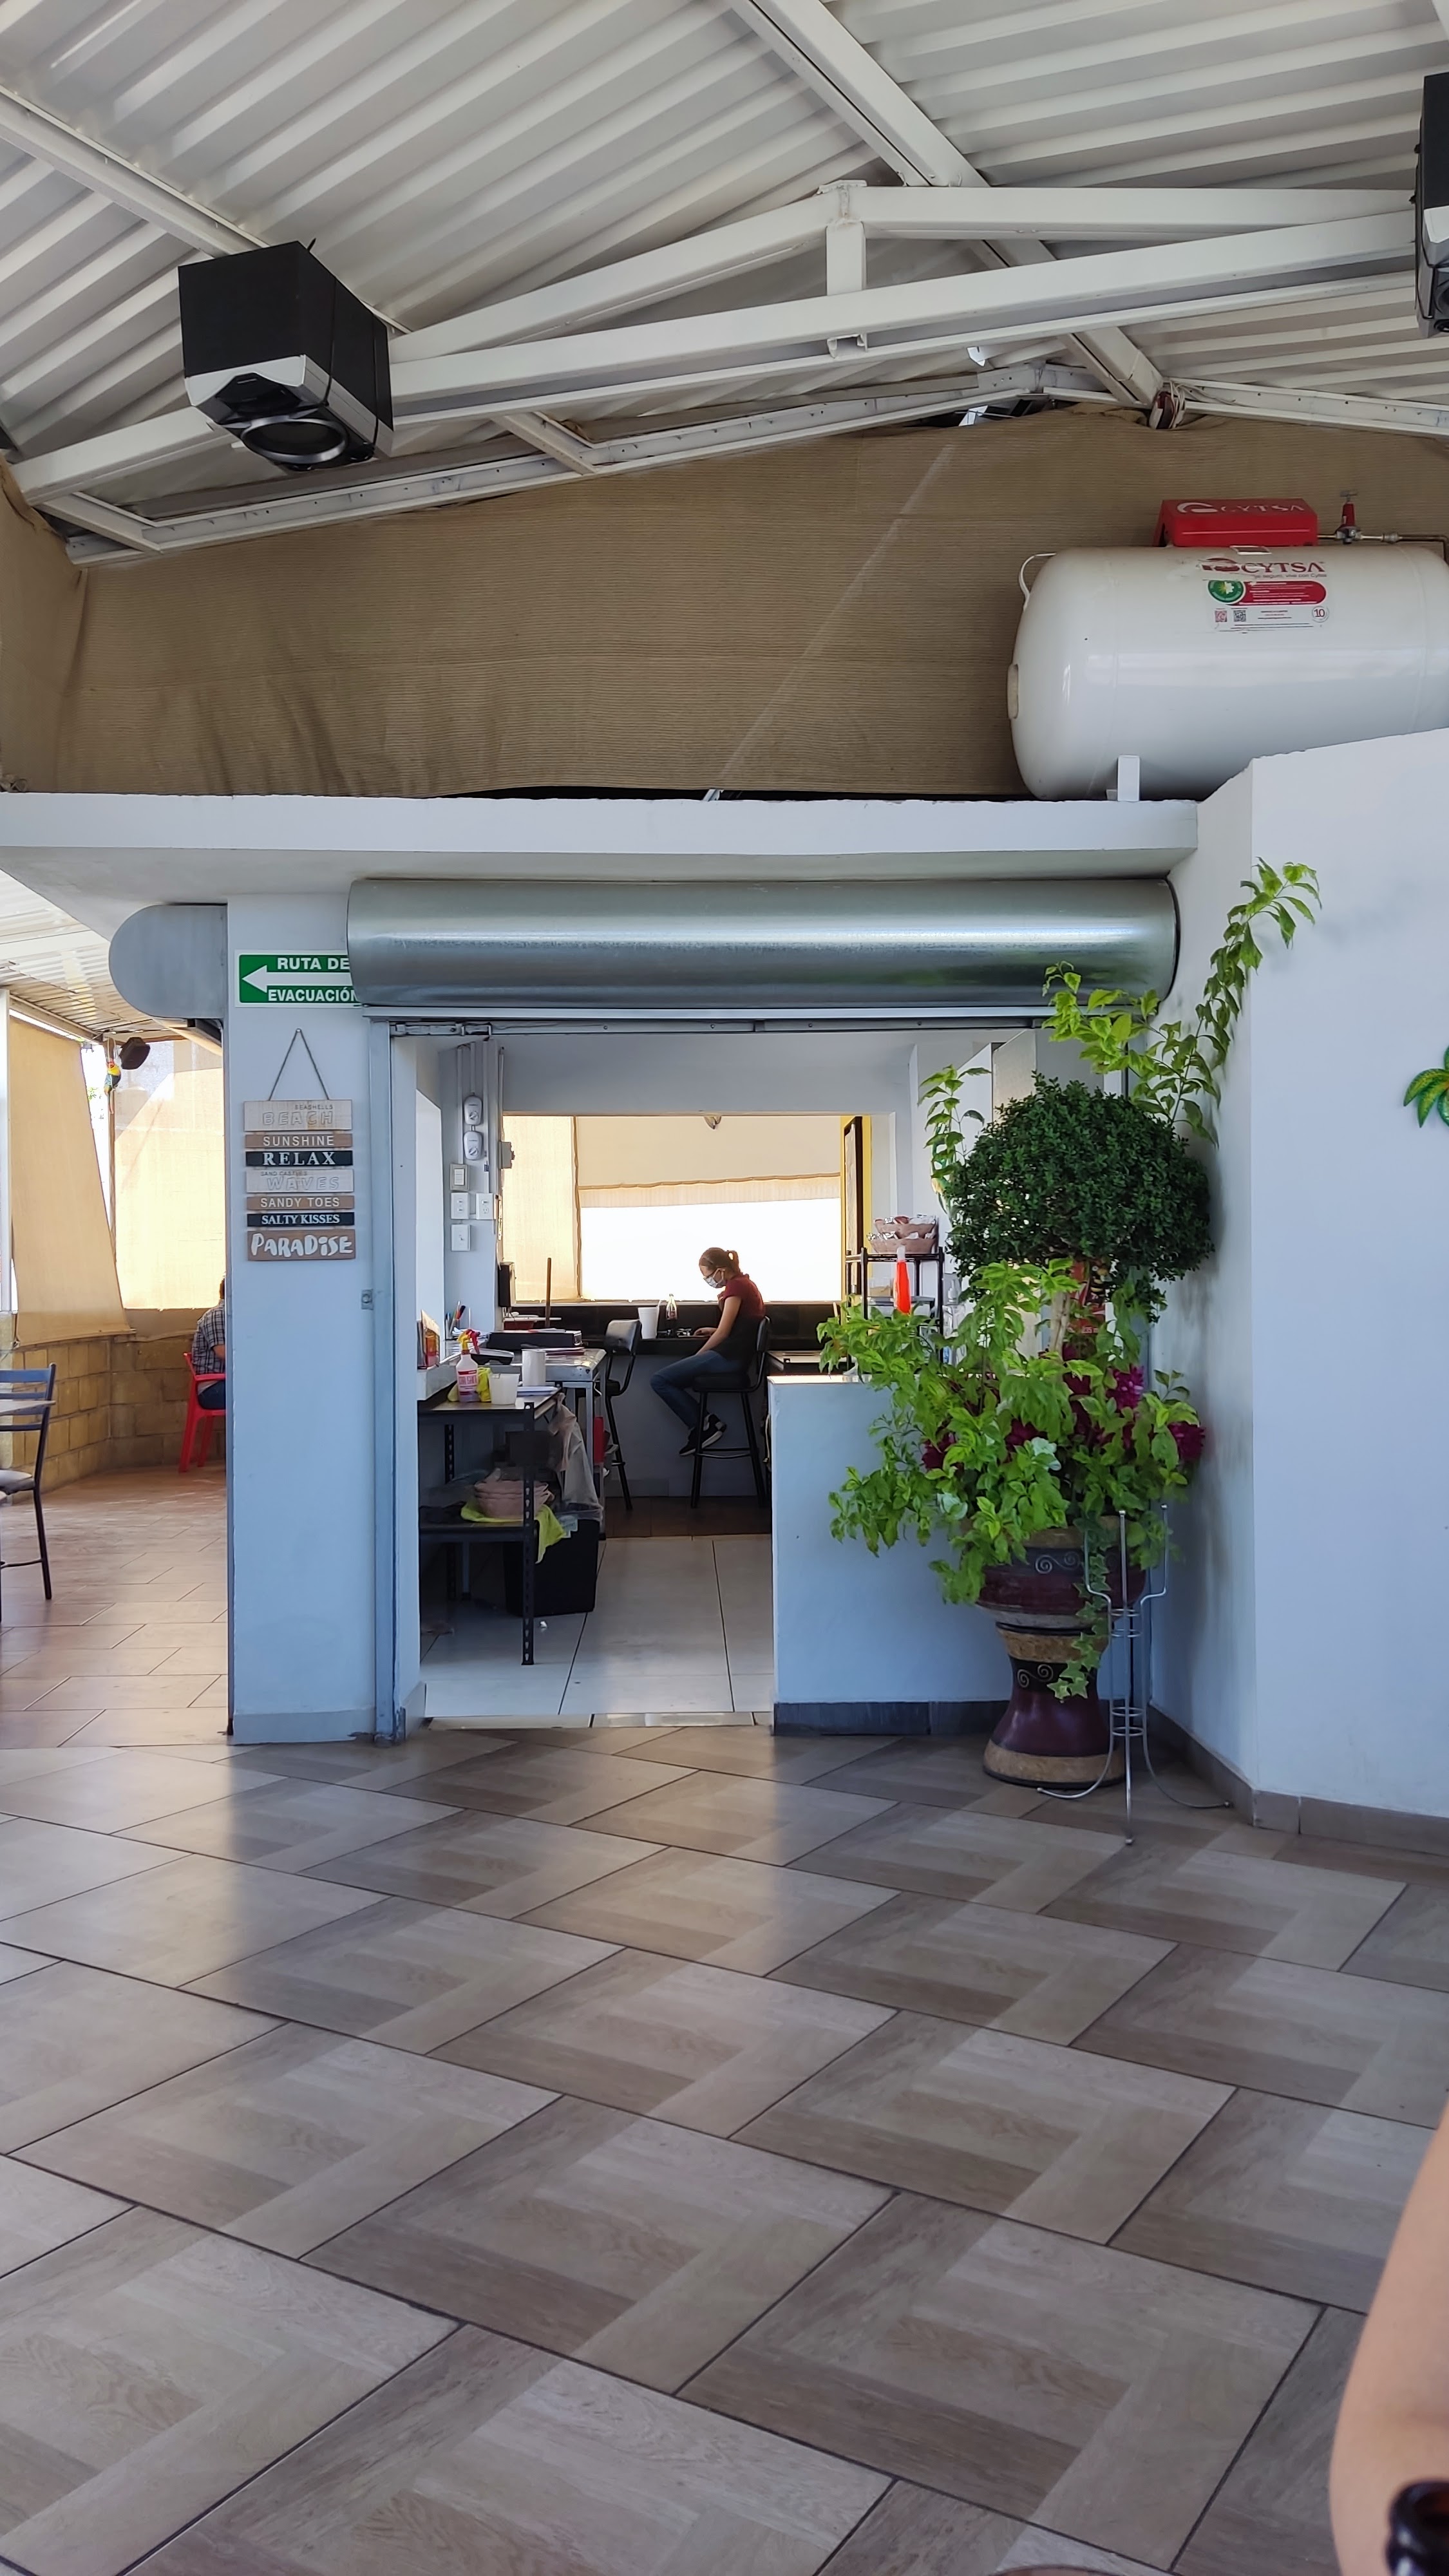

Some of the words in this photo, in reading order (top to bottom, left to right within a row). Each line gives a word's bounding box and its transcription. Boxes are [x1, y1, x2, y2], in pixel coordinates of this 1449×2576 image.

[1241, 562, 1325, 573] CYTSA
[1314, 609, 1325, 618] 10
[277, 958, 321, 970] RUTA
[328, 958, 350, 970] DE
[263, 1111, 332, 1125] BEACH
[263, 1135, 335, 1146] SUNSHINE
[263, 1151, 336, 1166] RELAX
[267, 1176, 339, 1191] WAVES
[260, 1198, 301, 1208] SANDY
[307, 1197, 340, 1207] TOES
[261, 1215, 298, 1224] SALTY
[300, 1214, 340, 1224] KISSES
